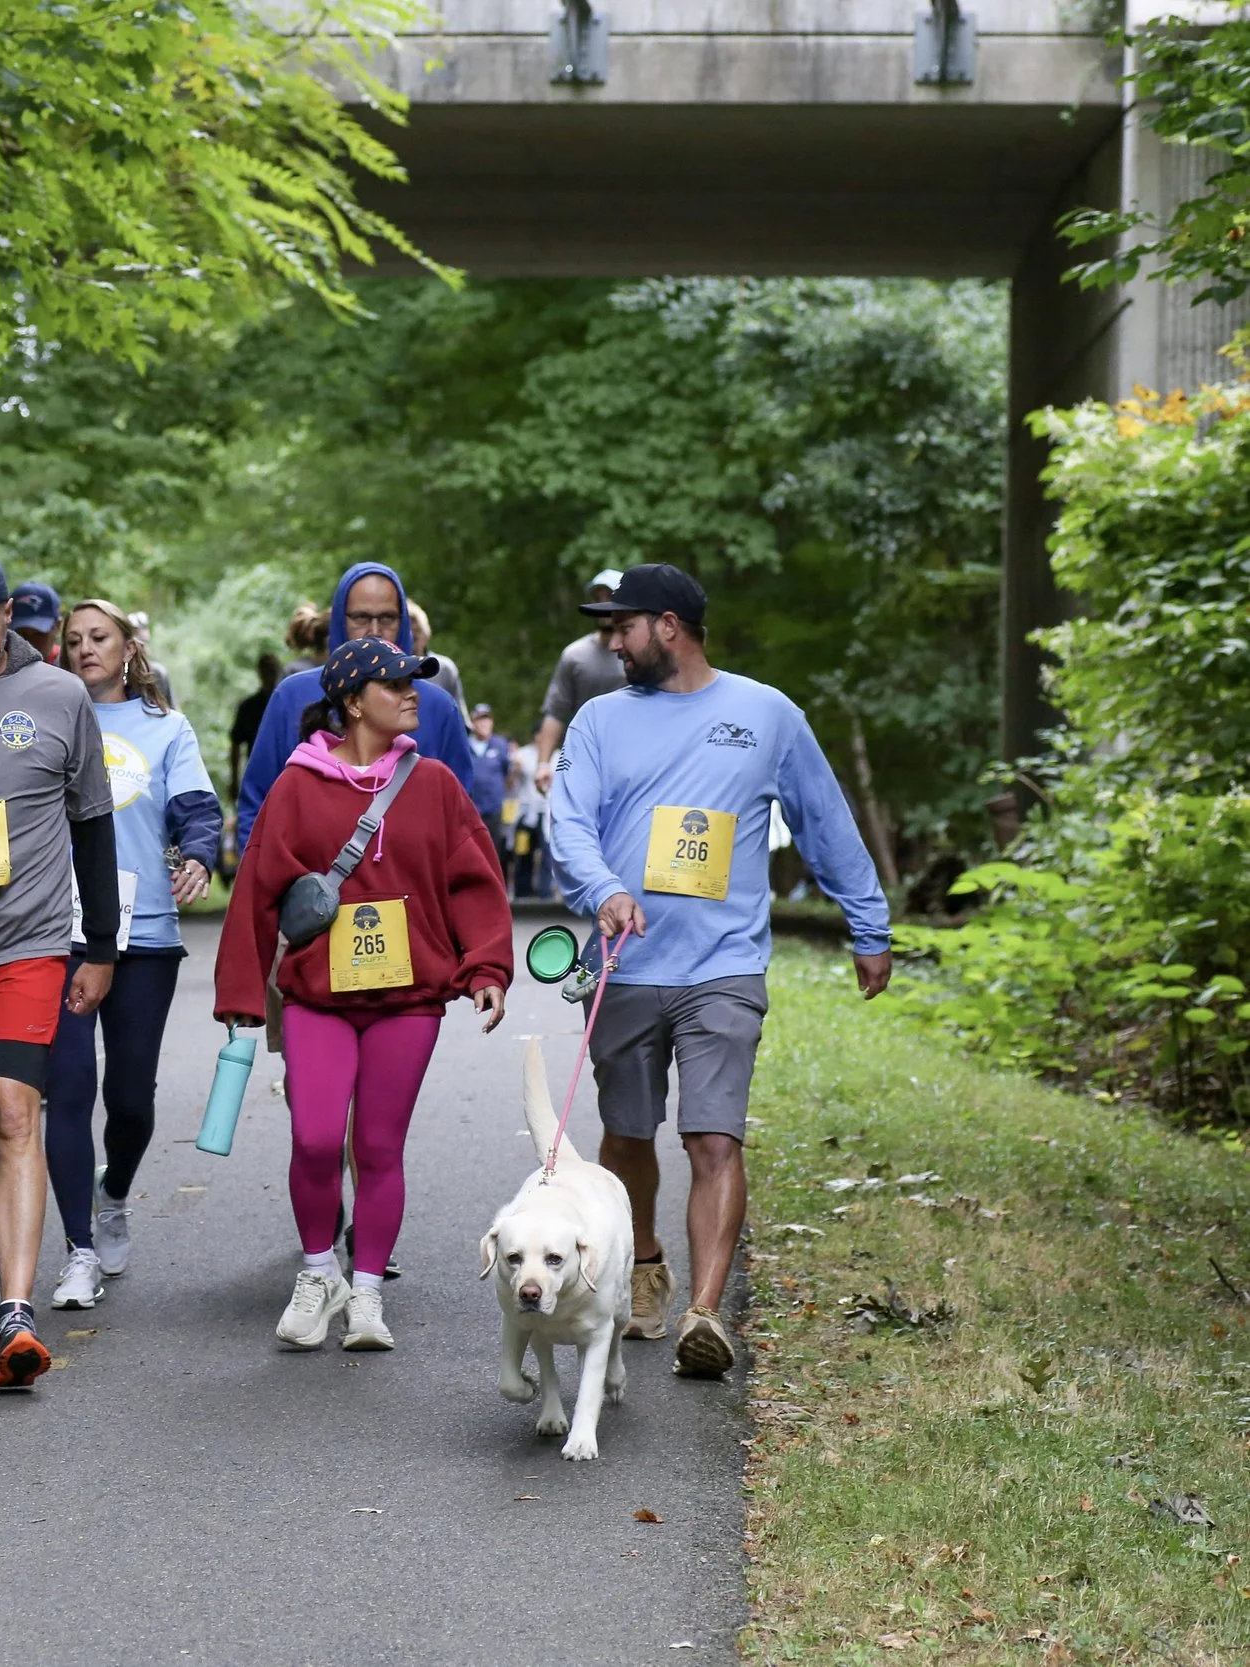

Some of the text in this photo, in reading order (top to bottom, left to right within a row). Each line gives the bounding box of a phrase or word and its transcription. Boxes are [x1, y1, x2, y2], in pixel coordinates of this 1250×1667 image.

[109, 767, 146, 782] RONG
[675, 839, 709, 862] 266
[353, 934, 385, 955] 265
